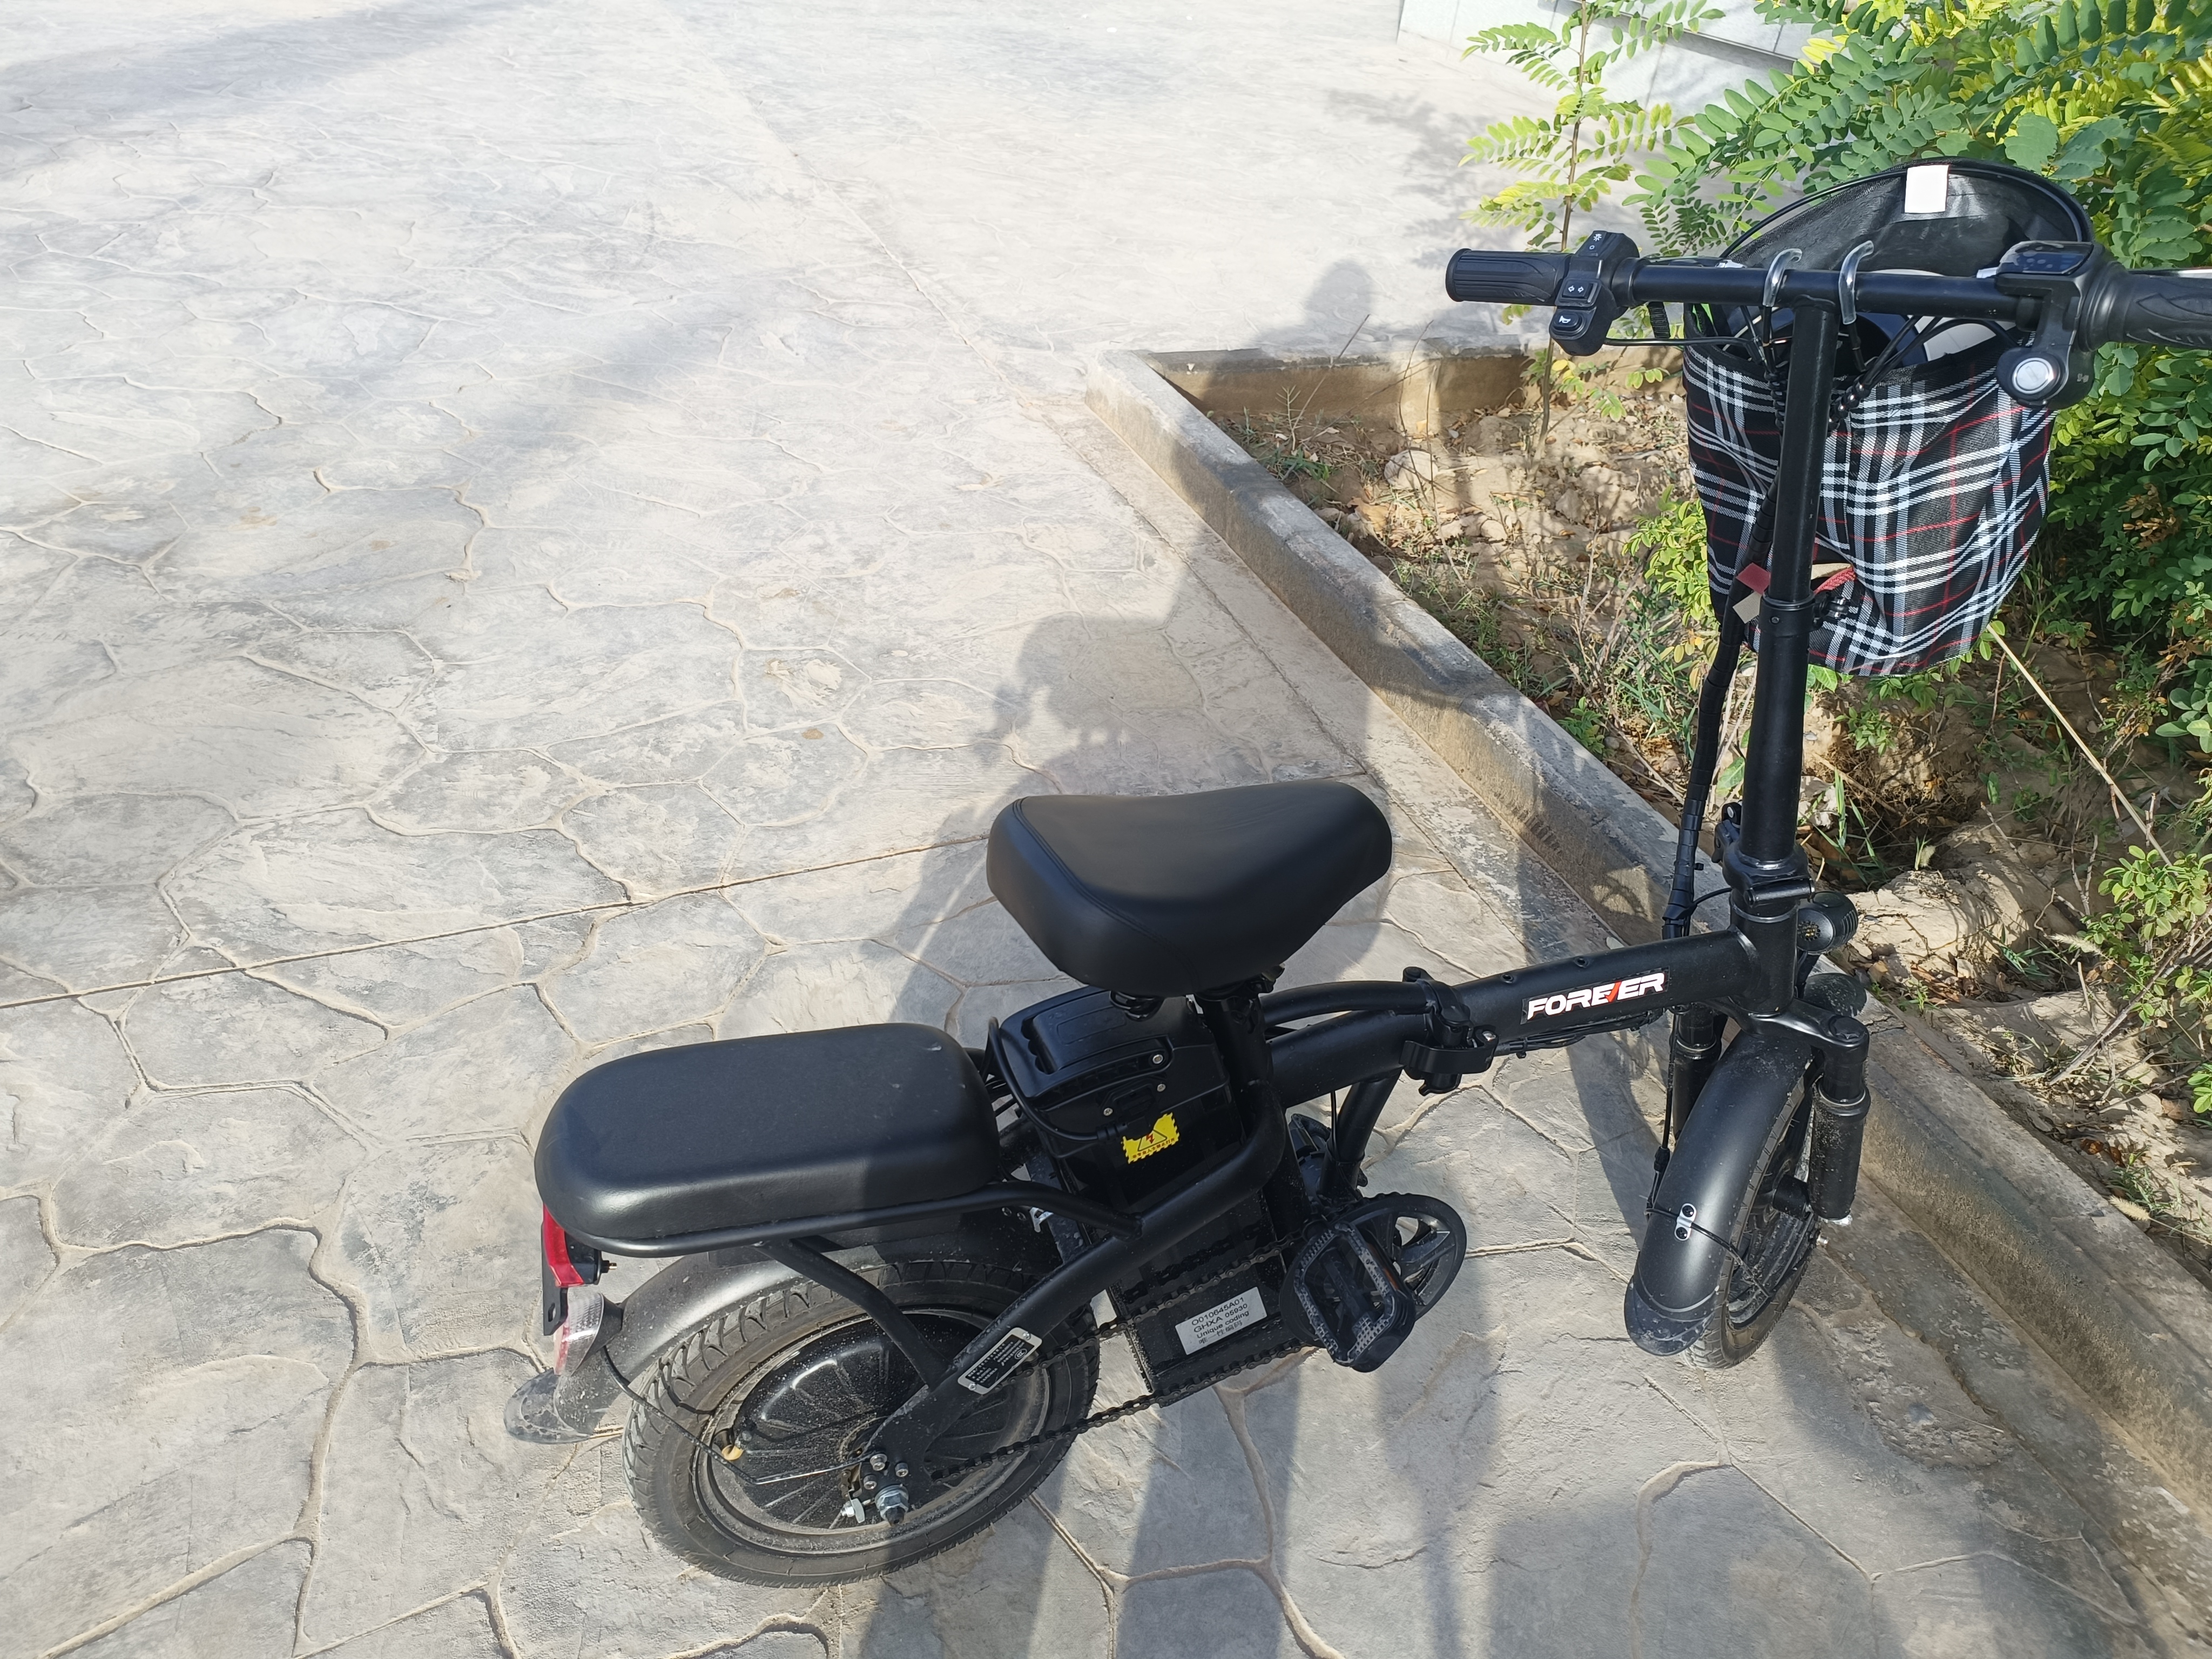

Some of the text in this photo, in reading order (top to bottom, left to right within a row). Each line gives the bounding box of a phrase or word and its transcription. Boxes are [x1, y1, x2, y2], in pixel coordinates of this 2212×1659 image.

[1527, 972, 1665, 1020] FOREVER
[1193, 1303, 1247, 1333] GHXA 05930
[1197, 1311, 1249, 1339] Unique coding
[1198, 1320, 1243, 1344] 唯一性编码
